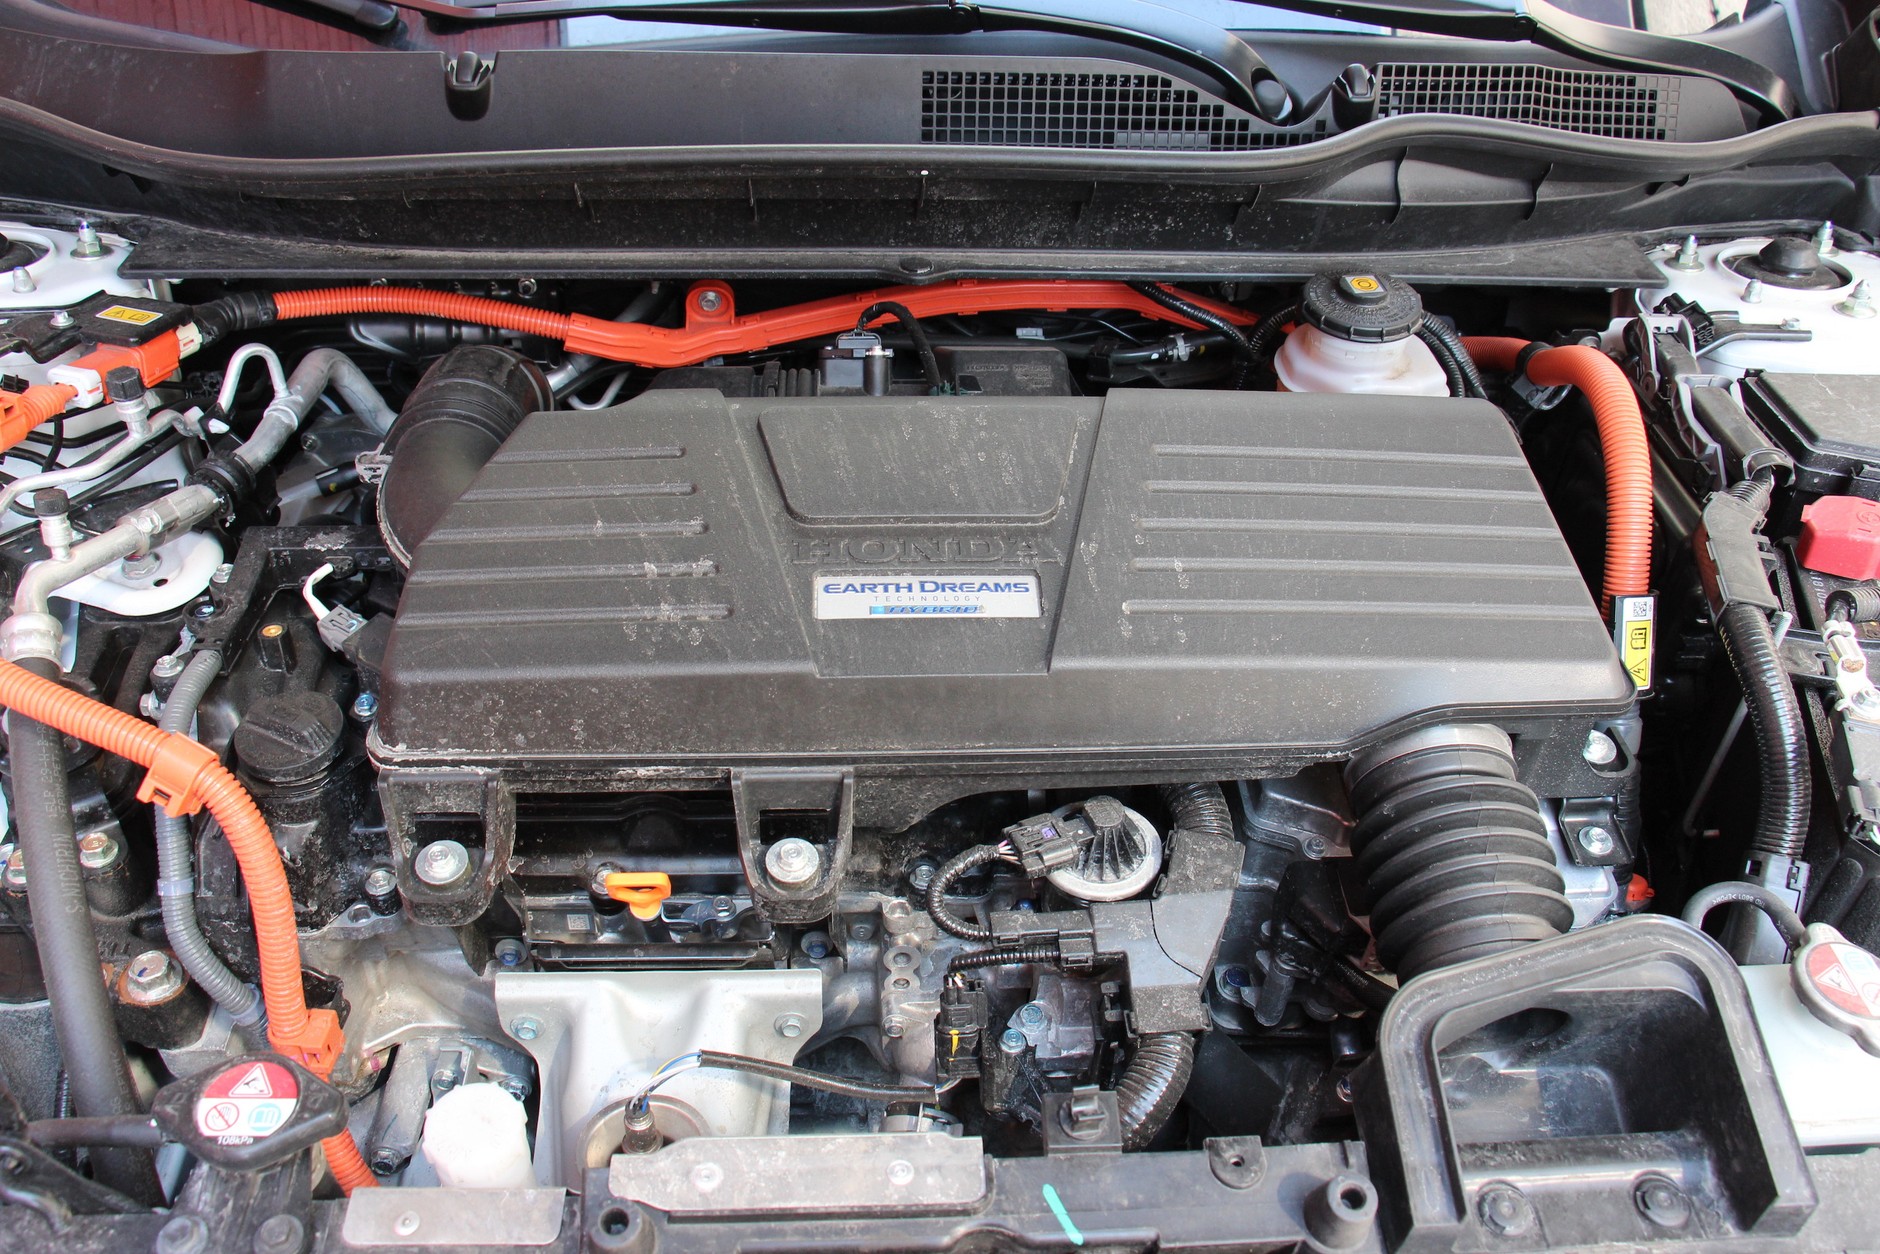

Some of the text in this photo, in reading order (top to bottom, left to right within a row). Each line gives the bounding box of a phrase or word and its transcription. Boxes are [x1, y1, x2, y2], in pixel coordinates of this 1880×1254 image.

[791, 538, 1061, 564] HONDA
[823, 581, 1030, 594] EARTH DREAMS
[889, 605, 978, 614] HYBRID
[217, 1135, 254, 1146] 108kPa
